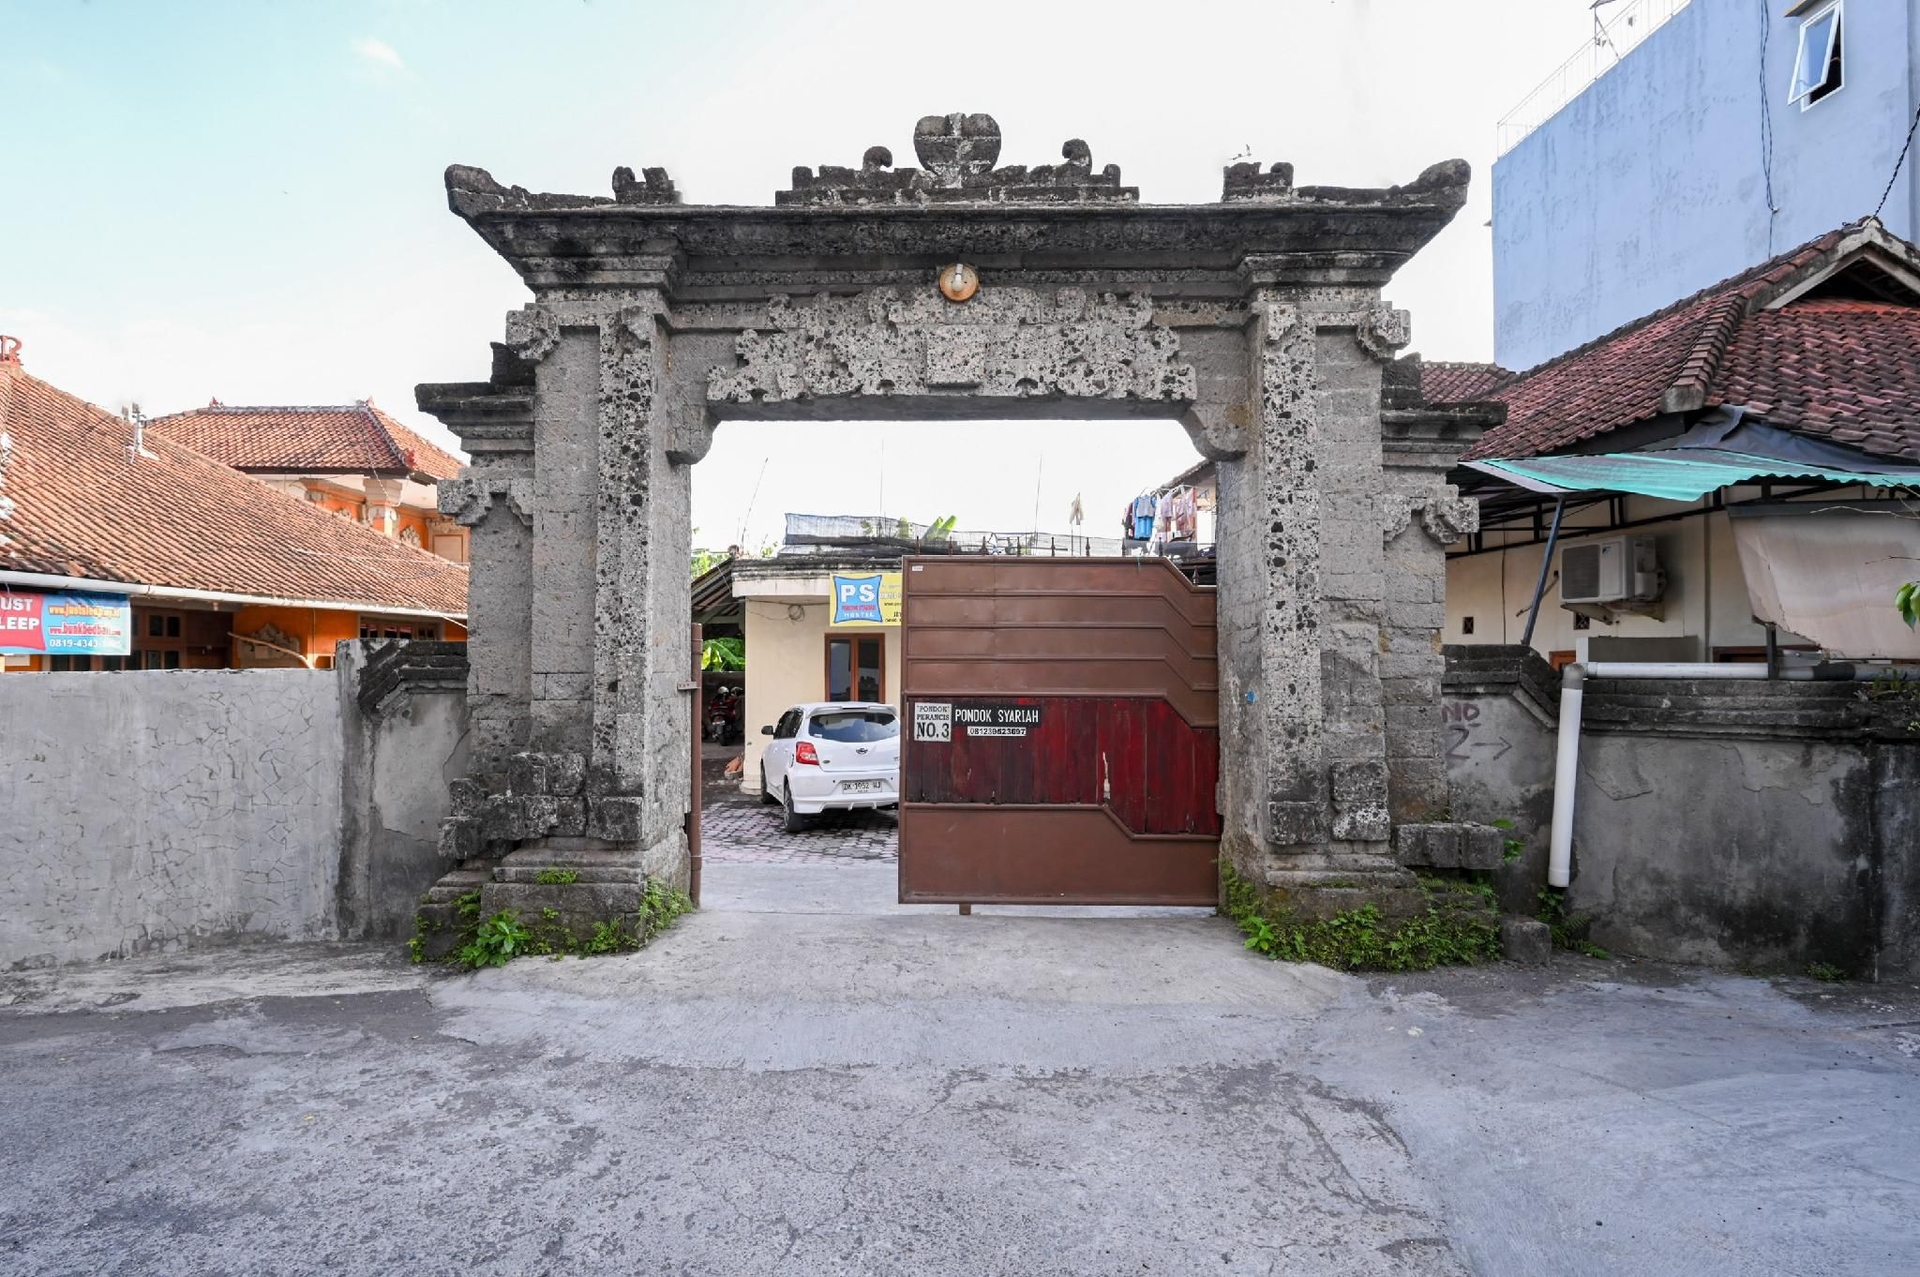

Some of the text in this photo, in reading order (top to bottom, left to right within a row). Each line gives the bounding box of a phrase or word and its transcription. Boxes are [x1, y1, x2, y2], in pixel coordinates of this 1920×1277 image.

[840, 584, 875, 603] PS
[955, 709, 1039, 723] PONDOK SYARIAH
